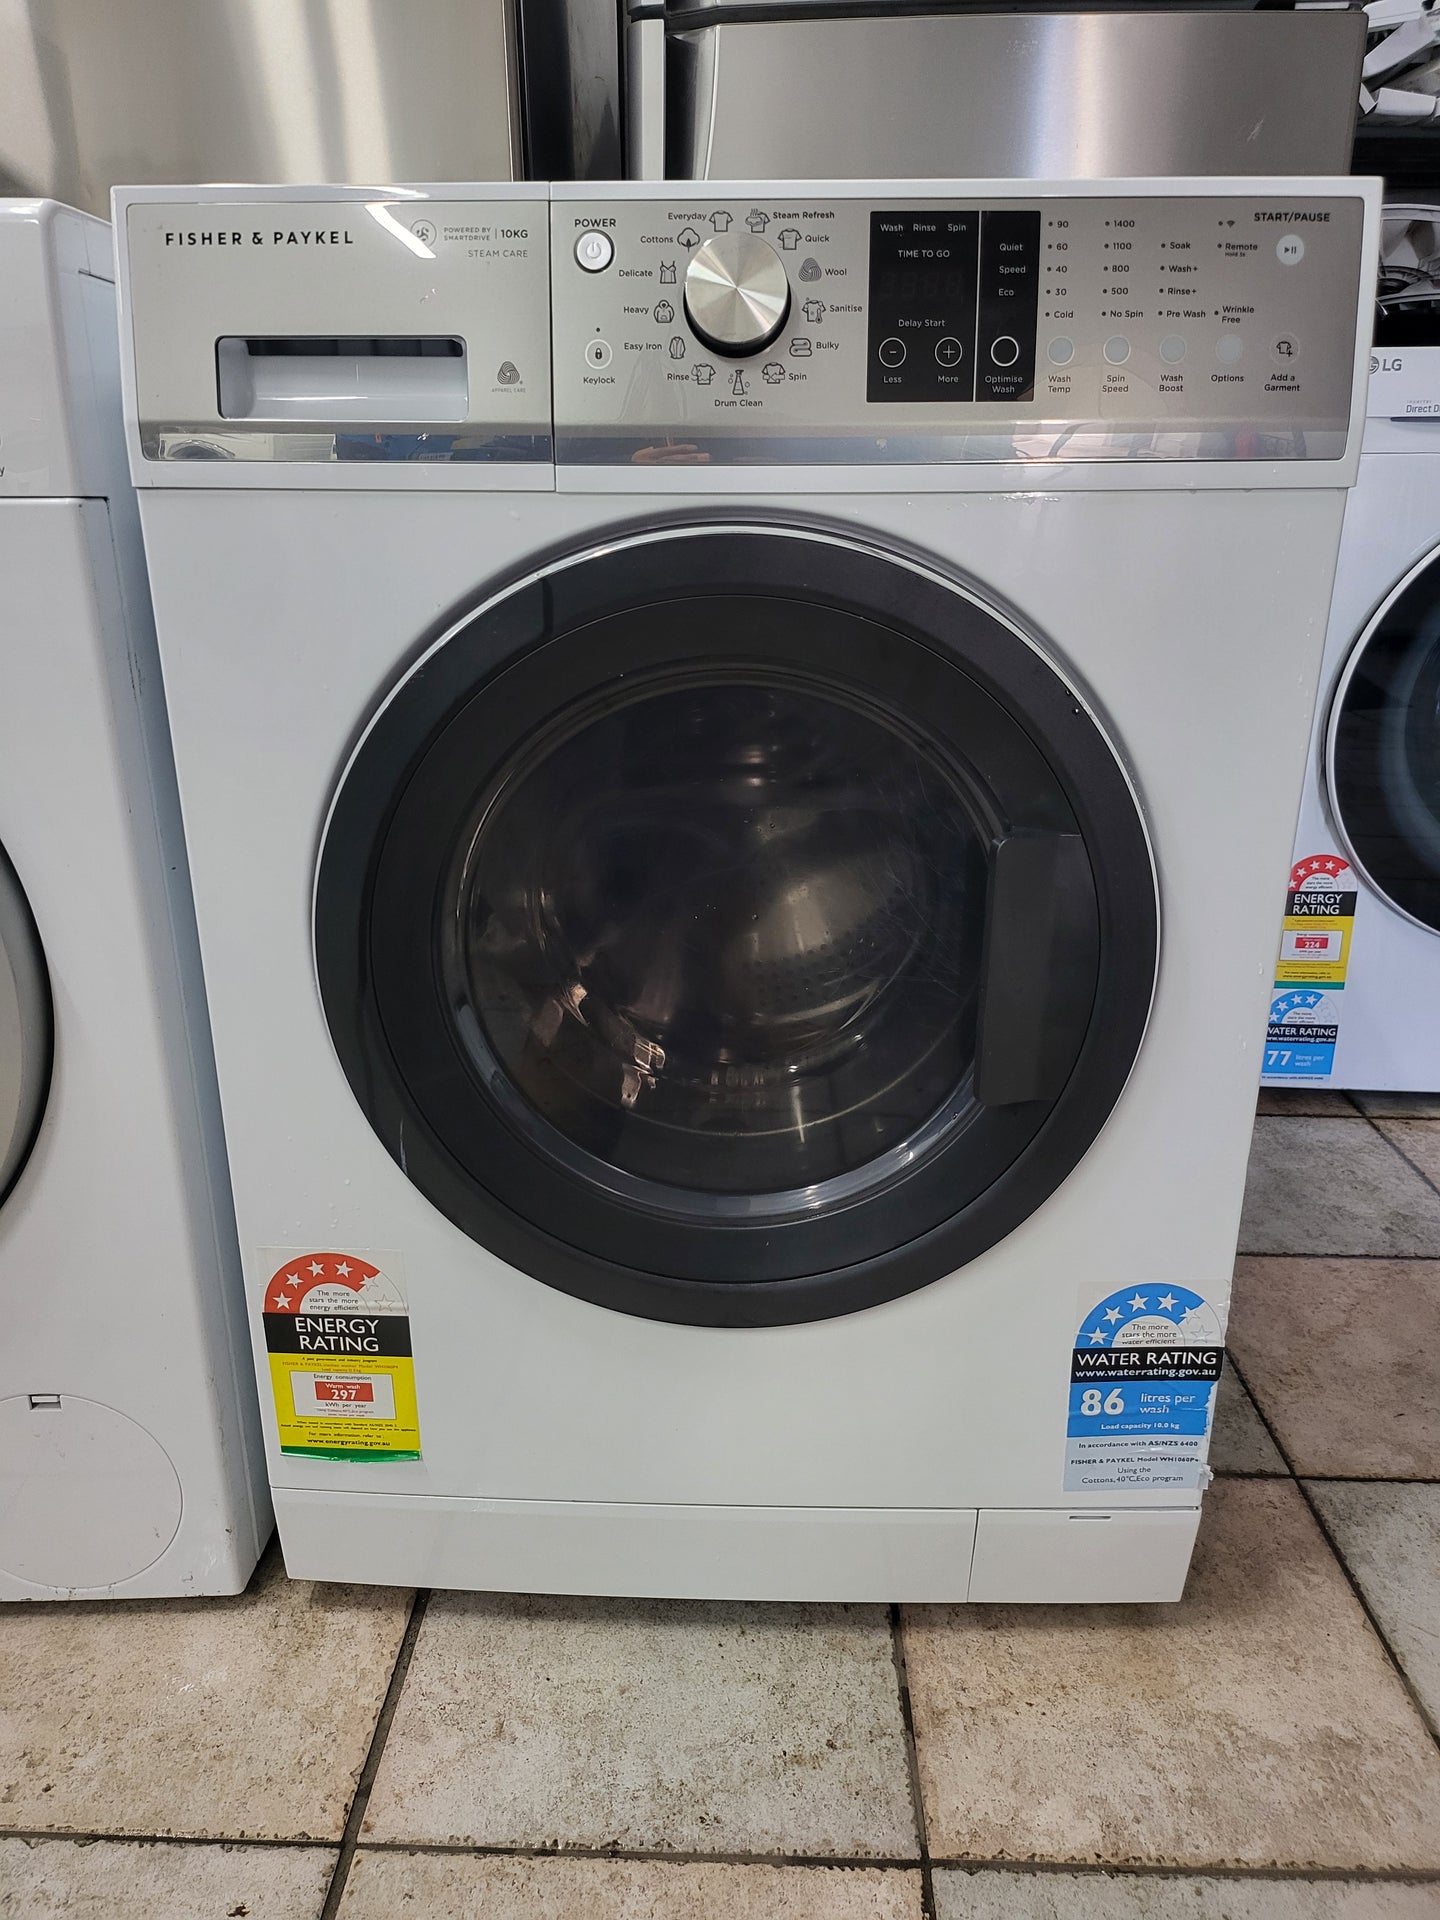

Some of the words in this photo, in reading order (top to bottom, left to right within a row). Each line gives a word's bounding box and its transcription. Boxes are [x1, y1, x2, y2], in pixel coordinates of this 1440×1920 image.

[668, 212, 707, 222] Everyday
[772, 211, 800, 219] Steam
[802, 211, 834, 219] Refresh
[1253, 212, 1330, 224] START/PAUSE
[574, 218, 616, 228] POWER
[947, 224, 966, 233] Spin
[165, 232, 242, 246] FISHER
[252, 231, 263, 245] &
[273, 231, 353, 245] PAYKEL
[500, 229, 529, 239] 10KG
[805, 234, 830, 243] Quick
[640, 235, 674, 244] Cottons
[1000, 243, 1023, 251] Quiet
[1113, 242, 1131, 250] 1100
[1170, 242, 1191, 250] Soak
[1225, 243, 1258, 251] Remote
[467, 249, 500, 258] STEAM
[503, 249, 529, 258] CARE
[898, 250, 919, 258] TIME
[922, 250, 933, 258] TO
[936, 250, 950, 258] GO
[618, 269, 653, 277] Delicate
[825, 268, 847, 276] Wool
[999, 266, 1026, 275] Speed
[1112, 265, 1130, 273] 800
[624, 306, 649, 315] Heavy
[829, 304, 862, 312] Sanitise
[1125, 311, 1143, 319] Spin
[1183, 310, 1206, 318] Wash
[898, 319, 922, 328] Delay
[924, 319, 945, 327] Start
[624, 342, 643, 352] Easy
[646, 342, 662, 350] Iron
[816, 342, 839, 350] Bulky
[1382, 359, 1402, 371] LG
[583, 376, 615, 384] Keylock
[789, 373, 807, 381] Spin
[938, 375, 959, 383] More
[985, 375, 1023, 385] Optimise
[1107, 375, 1125, 384] Spin
[1160, 374, 1183, 382] Wash
[1211, 374, 1244, 383] Options
[1271, 374, 1287, 382] Add
[1048, 386, 1070, 394] Temp
[1102, 385, 1129, 394] Speed
[1159, 384, 1183, 392] Boost
[1264, 384, 1300, 392] Garment
[714, 399, 737, 407] Drum
[739, 399, 762, 407] Clean
[1406, 404, 1432, 413] Direct
[1294, 894, 1342, 903] ENERGY
[1293, 905, 1340, 914] RATING
[1299, 1028, 1336, 1036] RATING
[1267, 1051, 1292, 1066] 77
[295, 1317, 380, 1335] ENERGY
[300, 1335, 379, 1352] RATING
[1077, 1353, 1141, 1366] WATER
[1146, 1352, 1217, 1365] RATING
[1076, 1368, 1216, 1377] www.waterrating.gov.au
[331, 1389, 357, 1400] 297
[1141, 1393, 1171, 1403] litres
[1175, 1394, 1195, 1405] per
[1080, 1387, 1124, 1416] 86
[1139, 1405, 1169, 1414] wash
